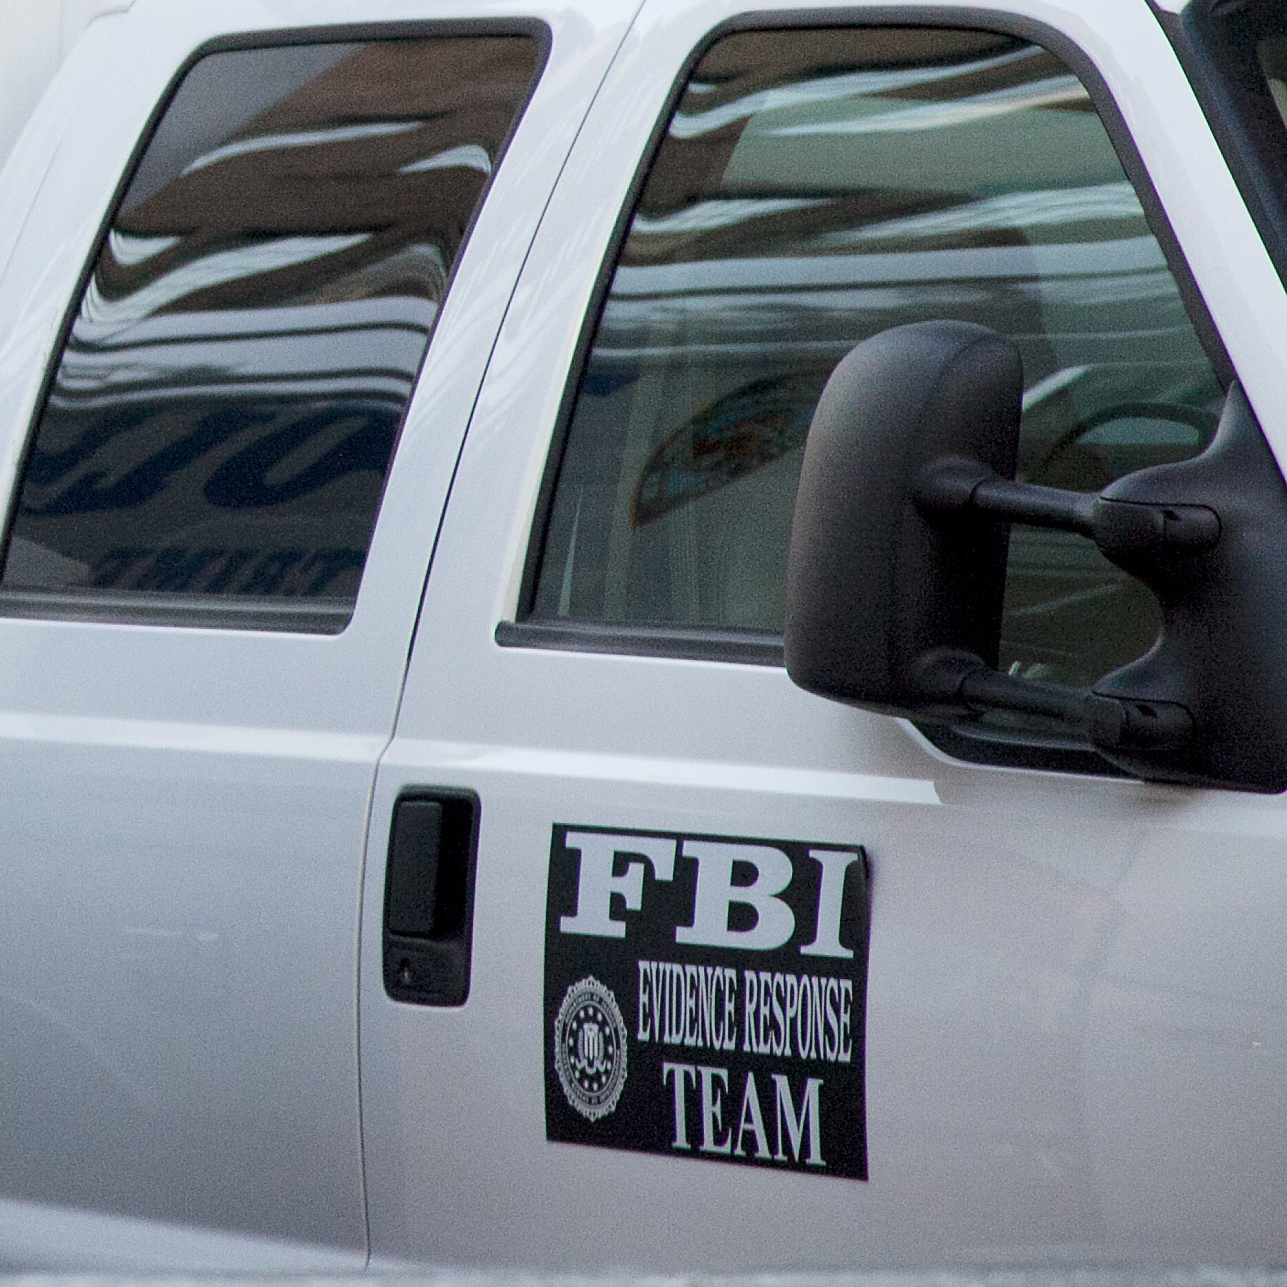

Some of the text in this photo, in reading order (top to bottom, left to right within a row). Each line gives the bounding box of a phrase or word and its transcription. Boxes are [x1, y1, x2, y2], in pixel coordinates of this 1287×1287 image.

[559, 831, 859, 960] FBI
[637, 960, 737, 1050] EVIDENCE
[743, 969, 854, 1063] RESPONSE
[662, 1062, 827, 1167] TEAM
